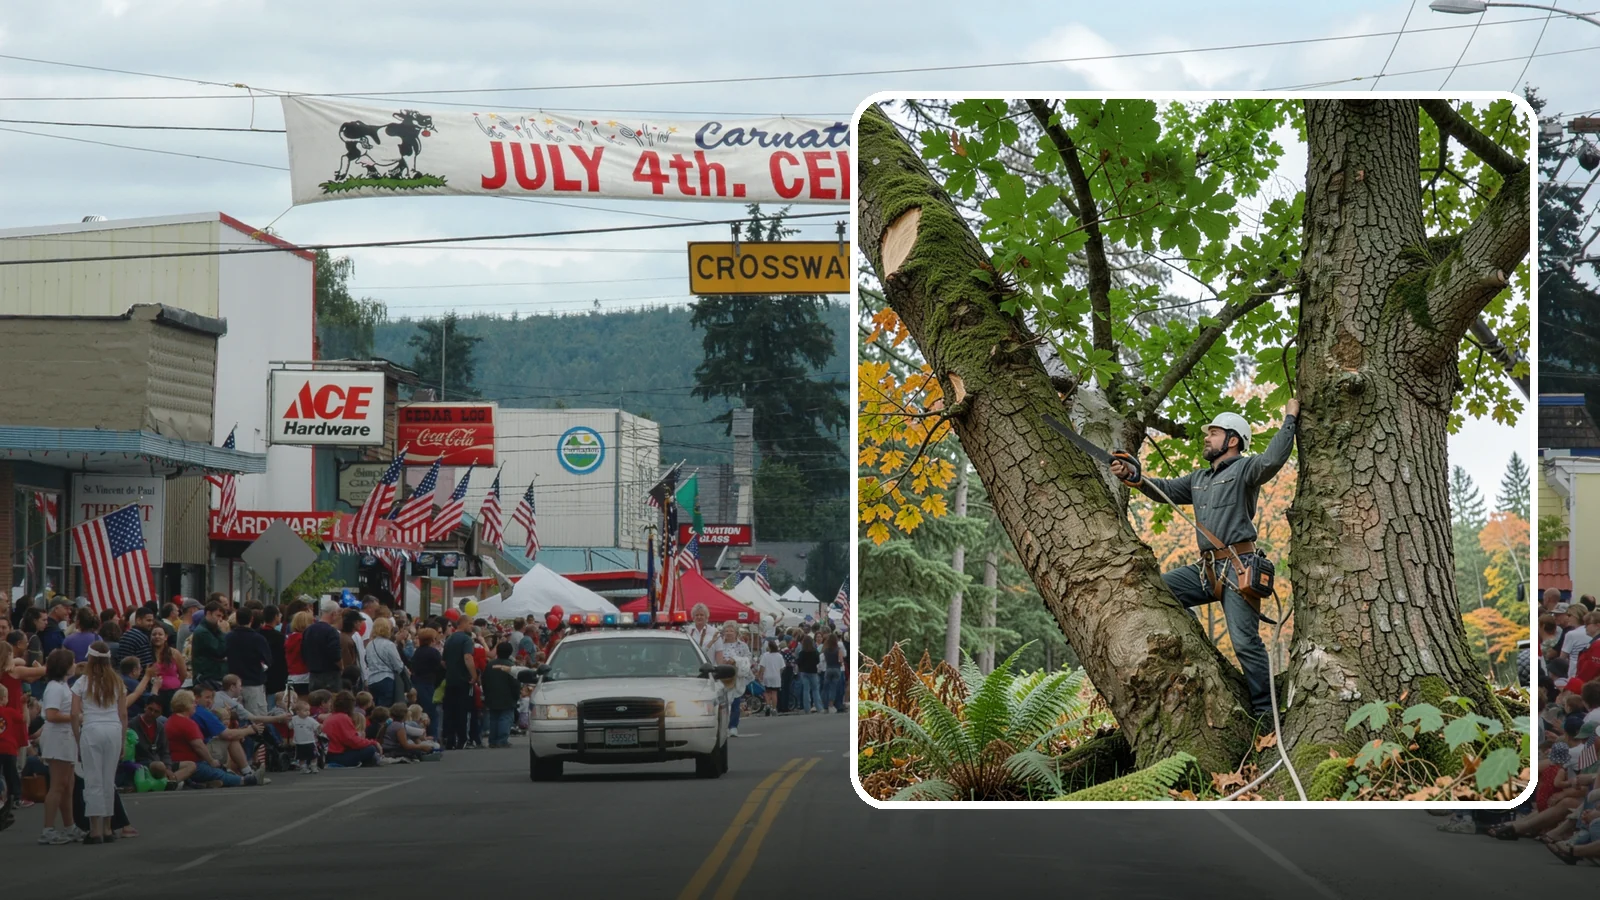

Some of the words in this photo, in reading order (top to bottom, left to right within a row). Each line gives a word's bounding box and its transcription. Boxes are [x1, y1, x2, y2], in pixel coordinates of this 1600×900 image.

[694, 121, 850, 150] Carnat
[481, 141, 605, 193] JULY
[633, 150, 746, 197] 4th.
[696, 254, 850, 281] CROSSWA
[283, 380, 373, 420] ACE
[405, 409, 452, 422] CEDAR
[283, 421, 370, 436] Hardware
[416, 427, 477, 447] Coca-Cola
[353, 467, 386, 479] Simpl
[96, 485, 124, 494] Vincent
[126, 486, 136, 494] de
[138, 486, 155, 495] Paul
[212, 516, 330, 535] HARDARE
[688, 526, 741, 535] CRNATION
[699, 535, 730, 543] GLASS
